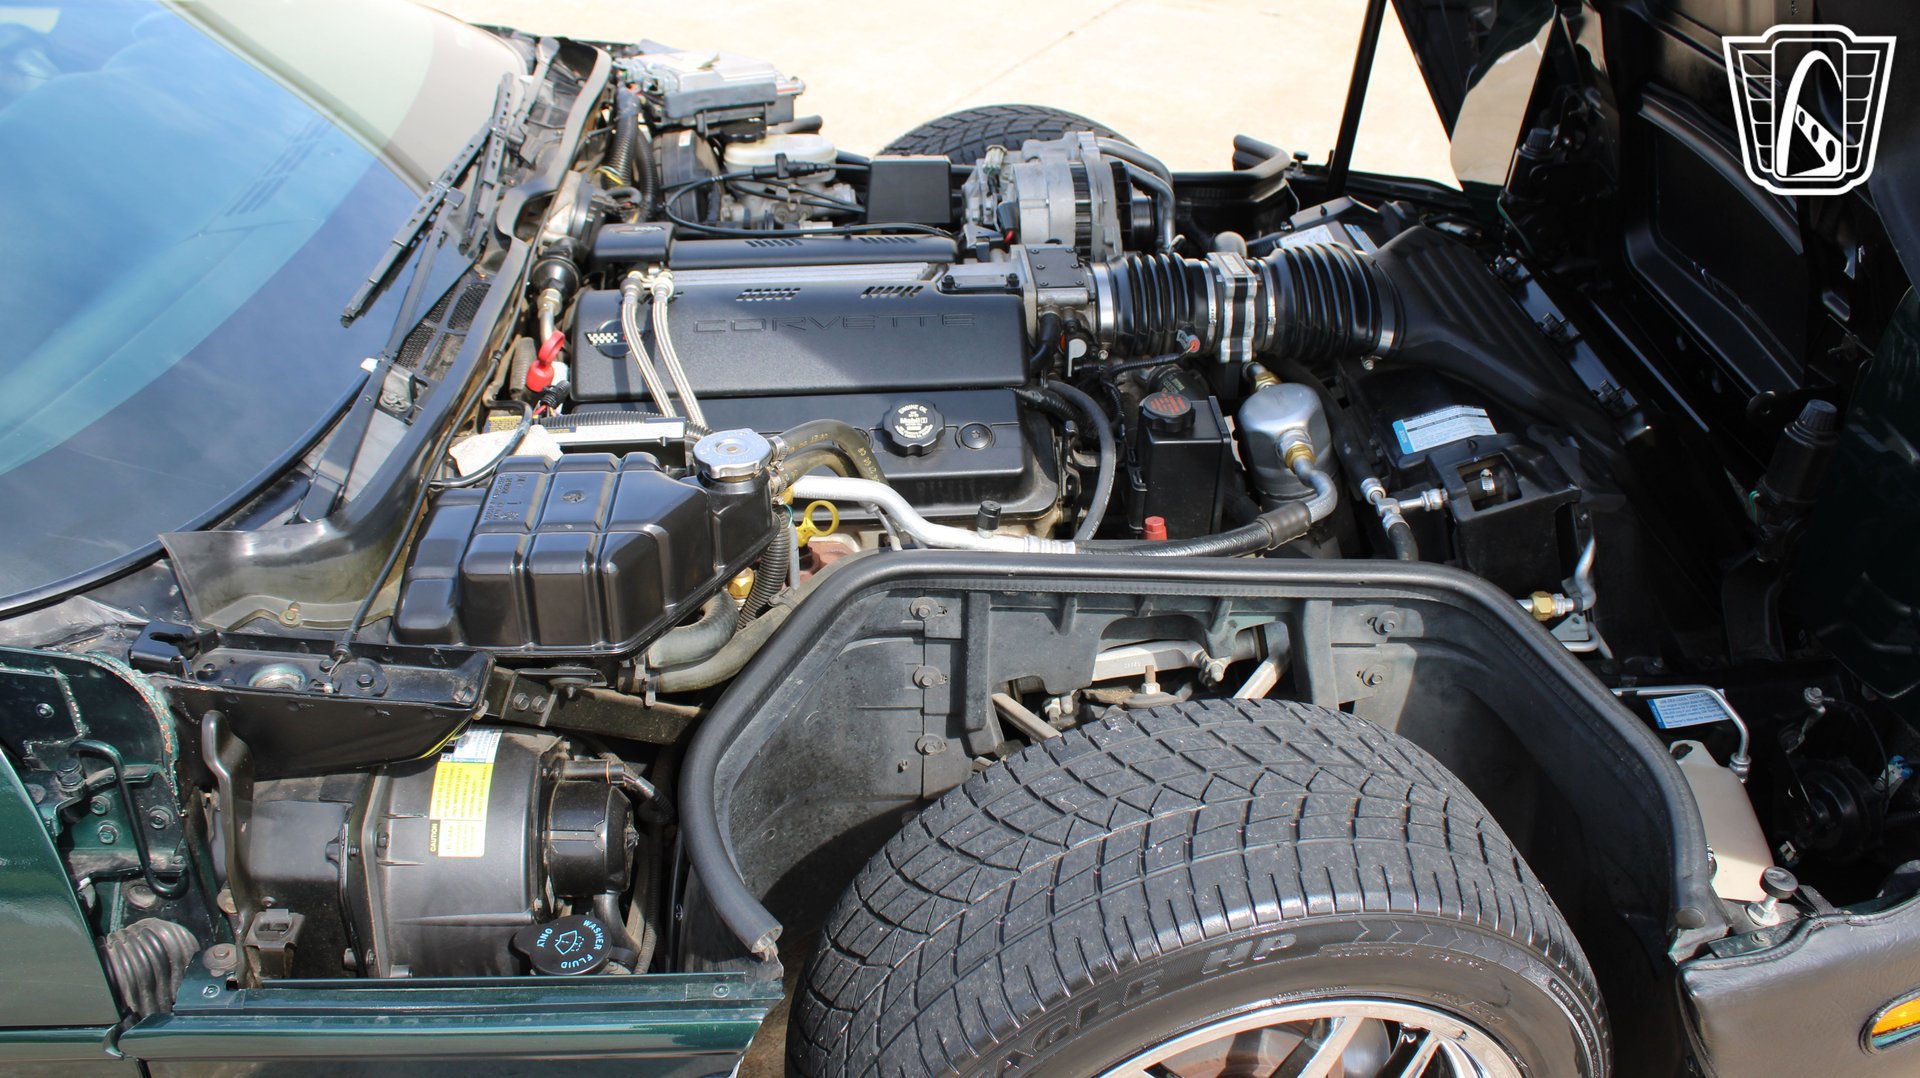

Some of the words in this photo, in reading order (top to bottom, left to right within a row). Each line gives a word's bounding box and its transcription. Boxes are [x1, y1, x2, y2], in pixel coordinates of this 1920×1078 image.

[693, 312, 977, 333] CORVETTE
[898, 404, 919, 415] ENGINE
[430, 823, 438, 853] CAUTION
[536, 927, 553, 948] ONLY
[582, 919, 604, 951] WASHER
[560, 953, 594, 969] FLUID
[1201, 933, 1297, 975] HP
